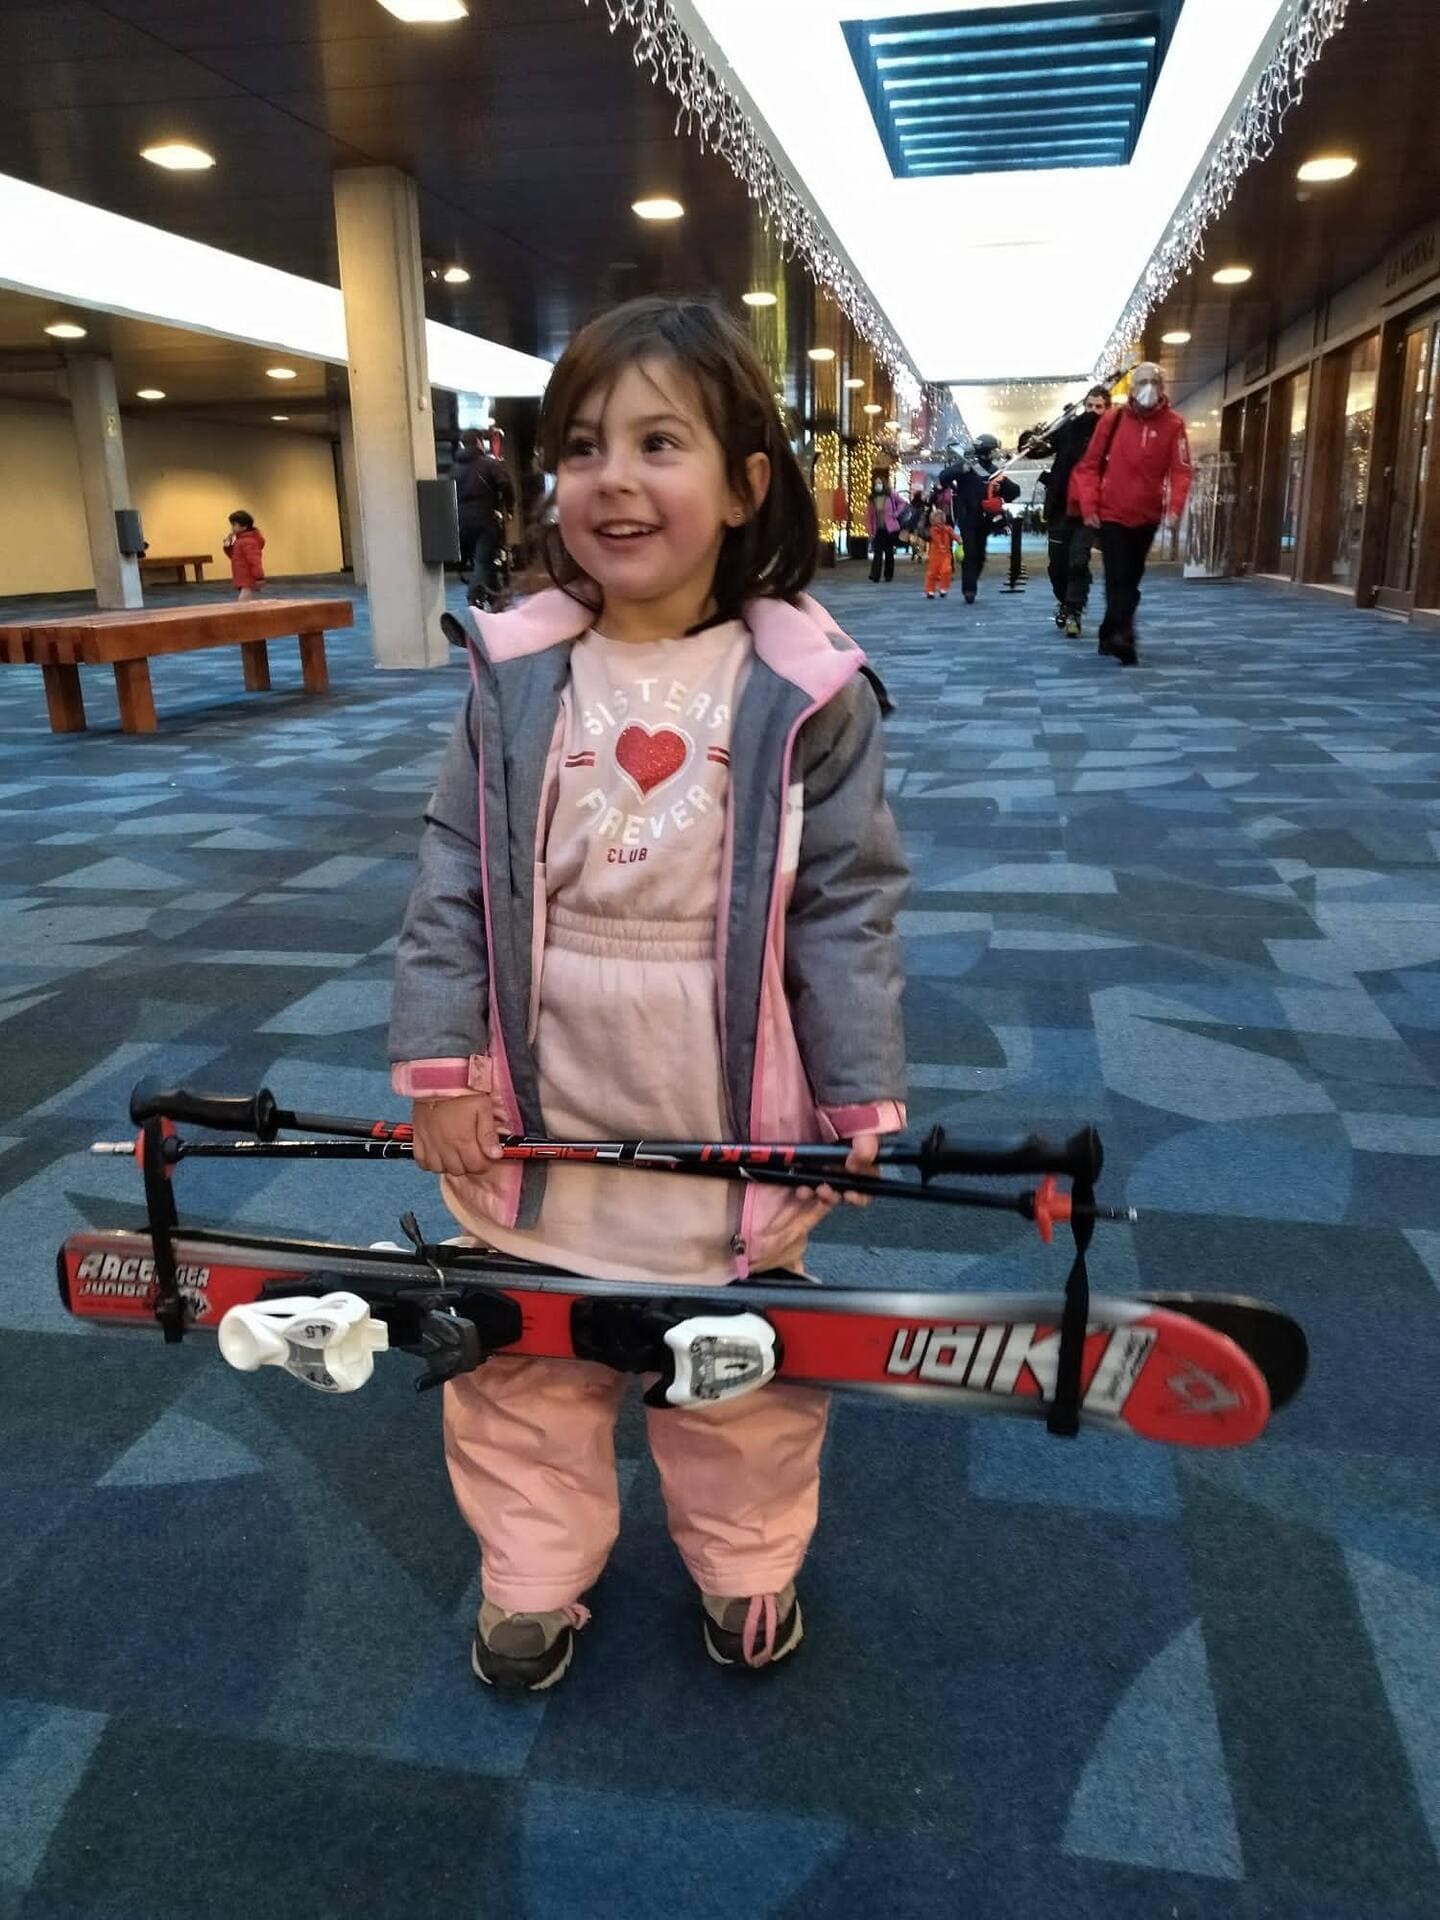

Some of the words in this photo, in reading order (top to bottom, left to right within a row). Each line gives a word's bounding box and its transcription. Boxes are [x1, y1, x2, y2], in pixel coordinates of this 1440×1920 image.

[583, 678, 729, 735] SISTERS
[576, 784, 713, 845] FREVER
[607, 848, 647, 863] CLUB
[77, 1253, 212, 1289] RACEGER
